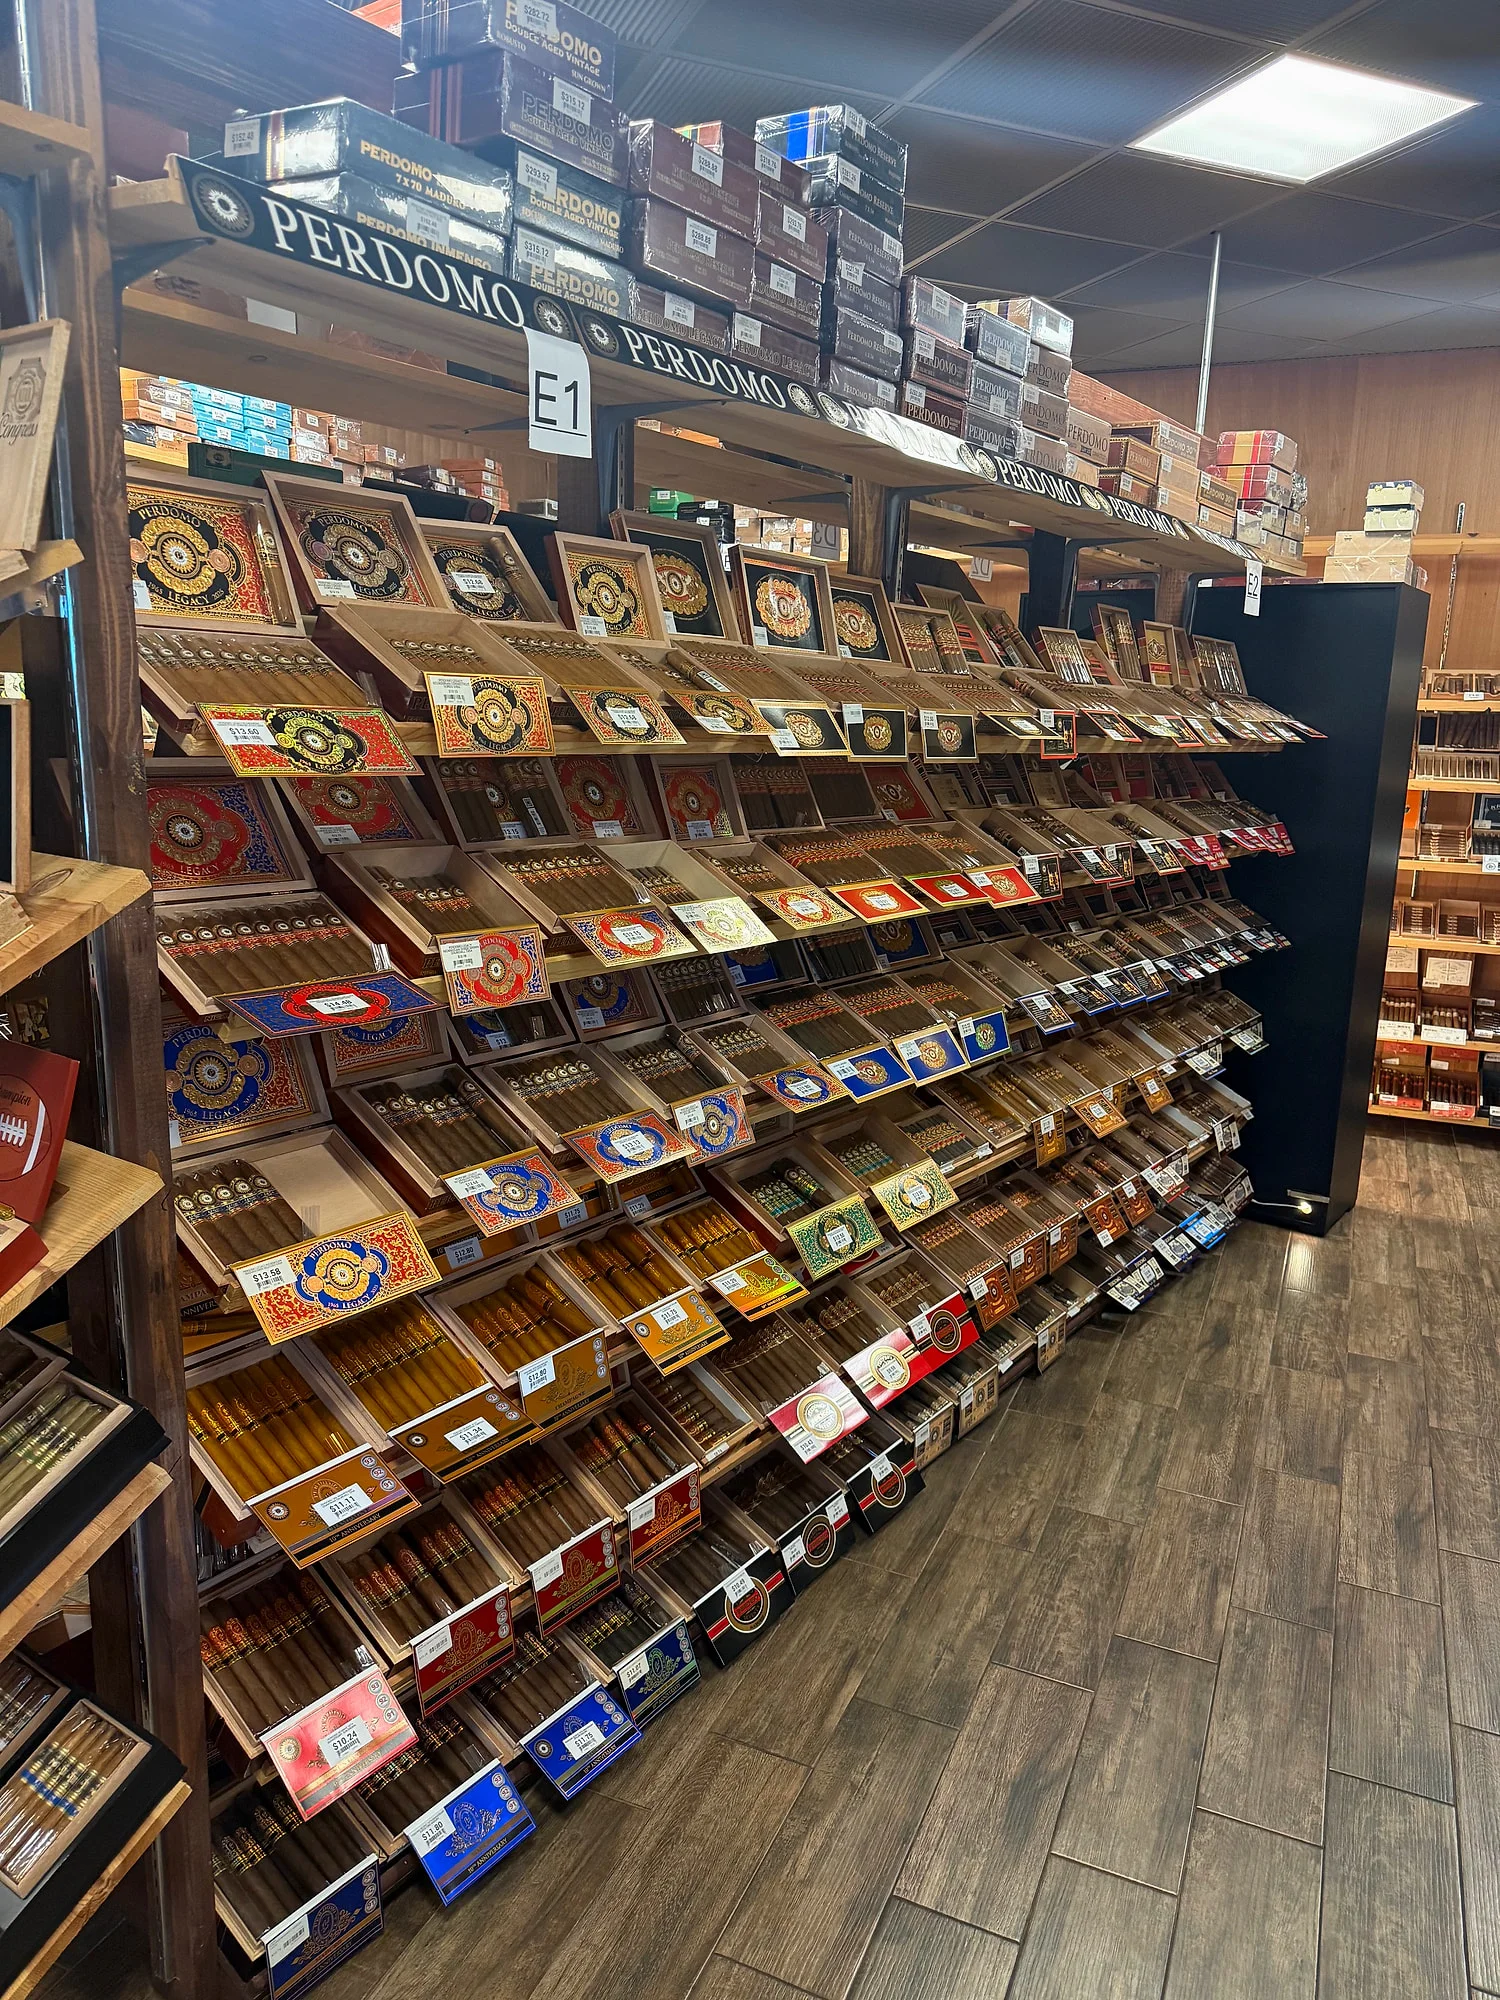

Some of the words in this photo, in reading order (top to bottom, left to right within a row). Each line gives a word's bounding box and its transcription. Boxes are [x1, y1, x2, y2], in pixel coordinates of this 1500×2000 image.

[541, 37, 565, 58] AGED
[566, 50, 601, 77] VINTAGE
[571, 69, 584, 81] SUN
[583, 75, 607, 93] GROWN
[360, 139, 433, 182] PERDOMO
[525, 163, 550, 183] $293.52
[530, 186, 620, 230] RDOMO
[563, 208, 586, 226] AGED
[586, 217, 619, 240] VINTAGE
[524, 239, 549, 257] $315.12
[261, 196, 525, 328] PERDOMO
[847, 329, 873, 349] PERDOMO
[984, 331, 1017, 354] PERDOMO
[618, 325, 786, 409] PERDOMO
[917, 351, 957, 376] PERDOMO
[1028, 361, 1066, 385] ERDOMO
[843, 383, 868, 401] PERDOMO
[975, 378, 1009, 401] PERDOMO
[534, 370, 578, 430] E1
[907, 402, 950, 429] PERDOMO
[969, 424, 1006, 449] PERDOMO
[1068, 423, 1108, 452] PERDOMO
[994, 456, 1082, 507] PERDOMO
[138, 503, 201, 529] PERDOMO
[317, 514, 369, 533] PERDOMO
[1108, 494, 1177, 537] PERDOMO
[439, 549, 484, 565] PERDOMO
[353, 583, 388, 596] LEGACY
[1247, 572, 1259, 598] E2
[167, 591, 211, 606] LEGACY
[476, 606, 506, 619] LEGACY
[278, 708, 324, 723] PERDOMO
[229, 726, 260, 736] $13.60
[315, 763, 346, 773] LEGACY
[180, 863, 221, 876] LEGACY
[362, 1029, 394, 1043] LEGACY
[202, 1104, 241, 1120] LEGACY
[564, 1207, 581, 1217] $11.75
[310, 1241, 352, 1261] PERDOMO
[454, 1246, 474, 1258] $12.80
[252, 1267, 282, 1283] $13.58
[342, 1293, 371, 1310] LEGACY
[528, 1368, 548, 1384] $12.80
[488, 1393, 497, 1402] 93
[498, 1402, 507, 1410] 92
[508, 1411, 516, 1419] 91
[561, 1398, 590, 1418] ANNIVERSARY
[459, 1426, 483, 1442] $11.34
[475, 1437, 511, 1459] ANNIVERSARY
[364, 1456, 374, 1465] 93
[373, 1468, 384, 1477] 92
[383, 1480, 393, 1489] 91
[329, 1495, 356, 1514] $11.11
[340, 1512, 381, 1538] ANNIVERSARY
[571, 1588, 599, 1611] ANNIVERSARY
[371, 1682, 380, 1691] 93
[379, 1695, 388, 1705] 92
[387, 1710, 396, 1719] 91
[332, 1730, 358, 1752] $10.24
[575, 1732, 594, 1748] $11.75
[591, 1743, 617, 1768] ANNIVERSARY
[509, 1801, 516, 1809] 91
[422, 1820, 444, 1842] $11.80
[476, 1837, 508, 1868] ANNIVERSARY
